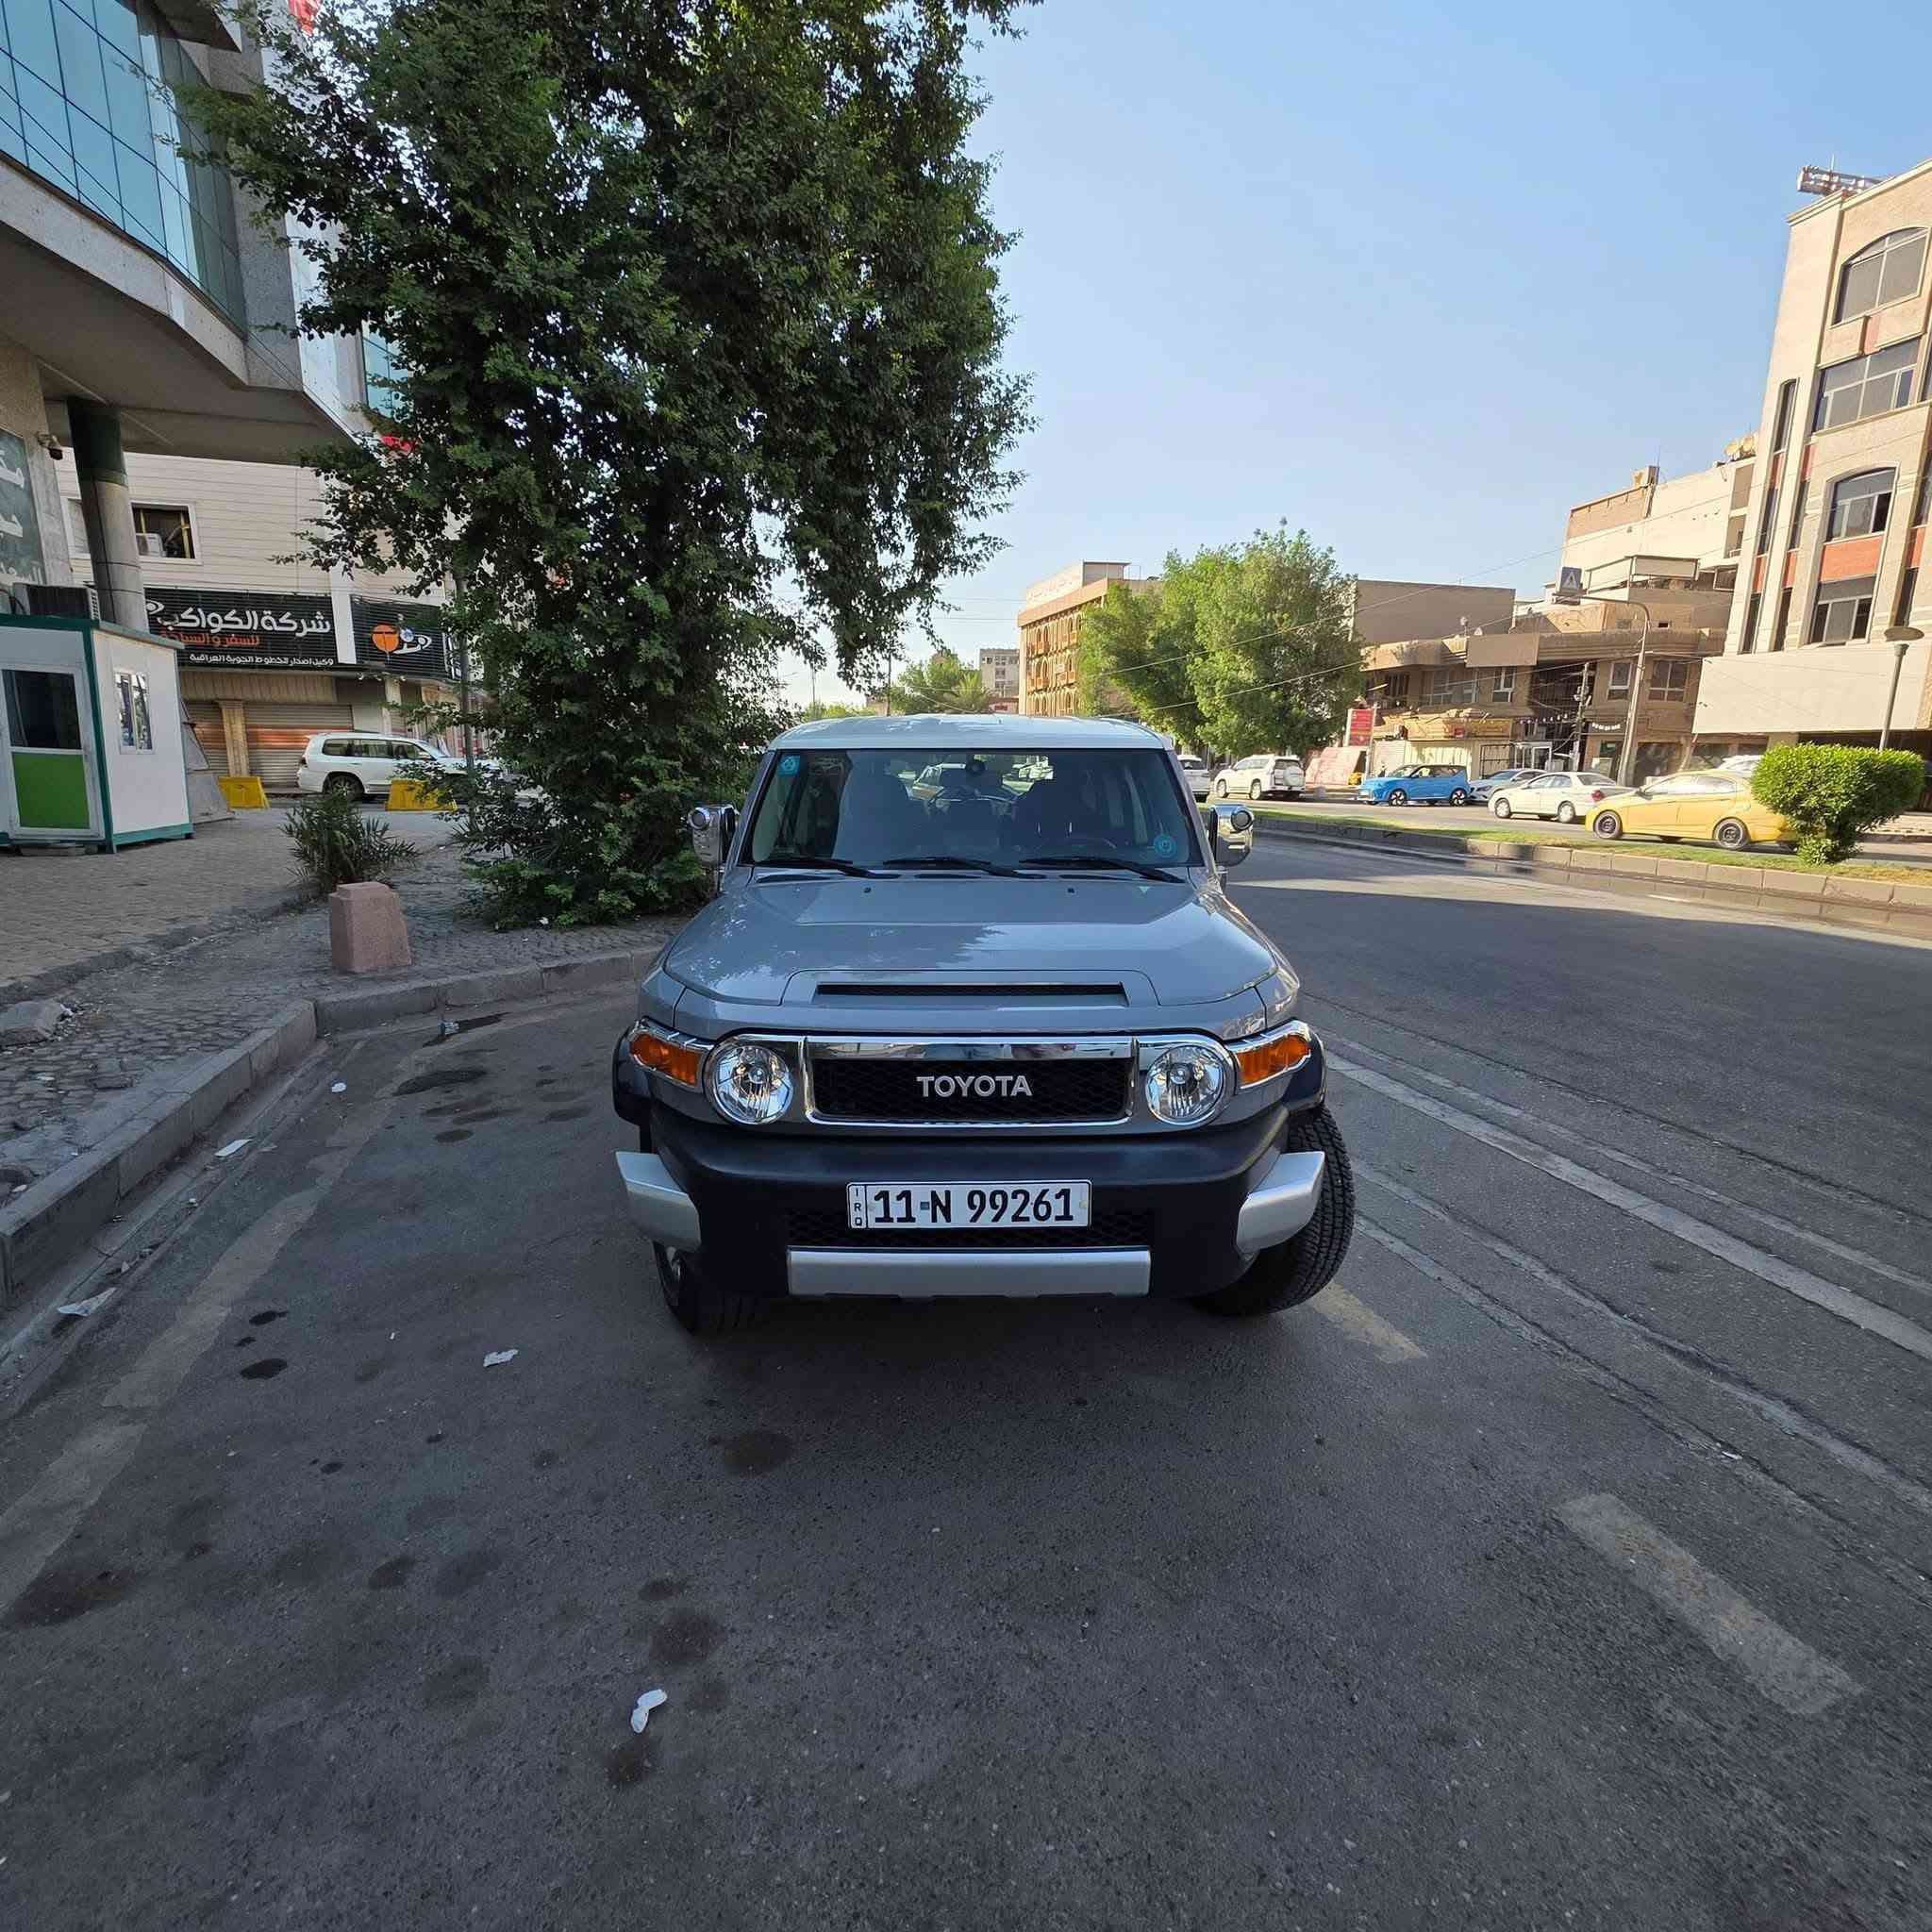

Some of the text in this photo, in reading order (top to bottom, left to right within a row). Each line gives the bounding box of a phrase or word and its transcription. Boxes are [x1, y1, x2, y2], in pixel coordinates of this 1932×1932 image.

[157, 607, 330, 637] شركة الكواكب
[916, 1075, 1033, 1097] TOYOTA
[966, 1189, 1074, 1223] 99261
